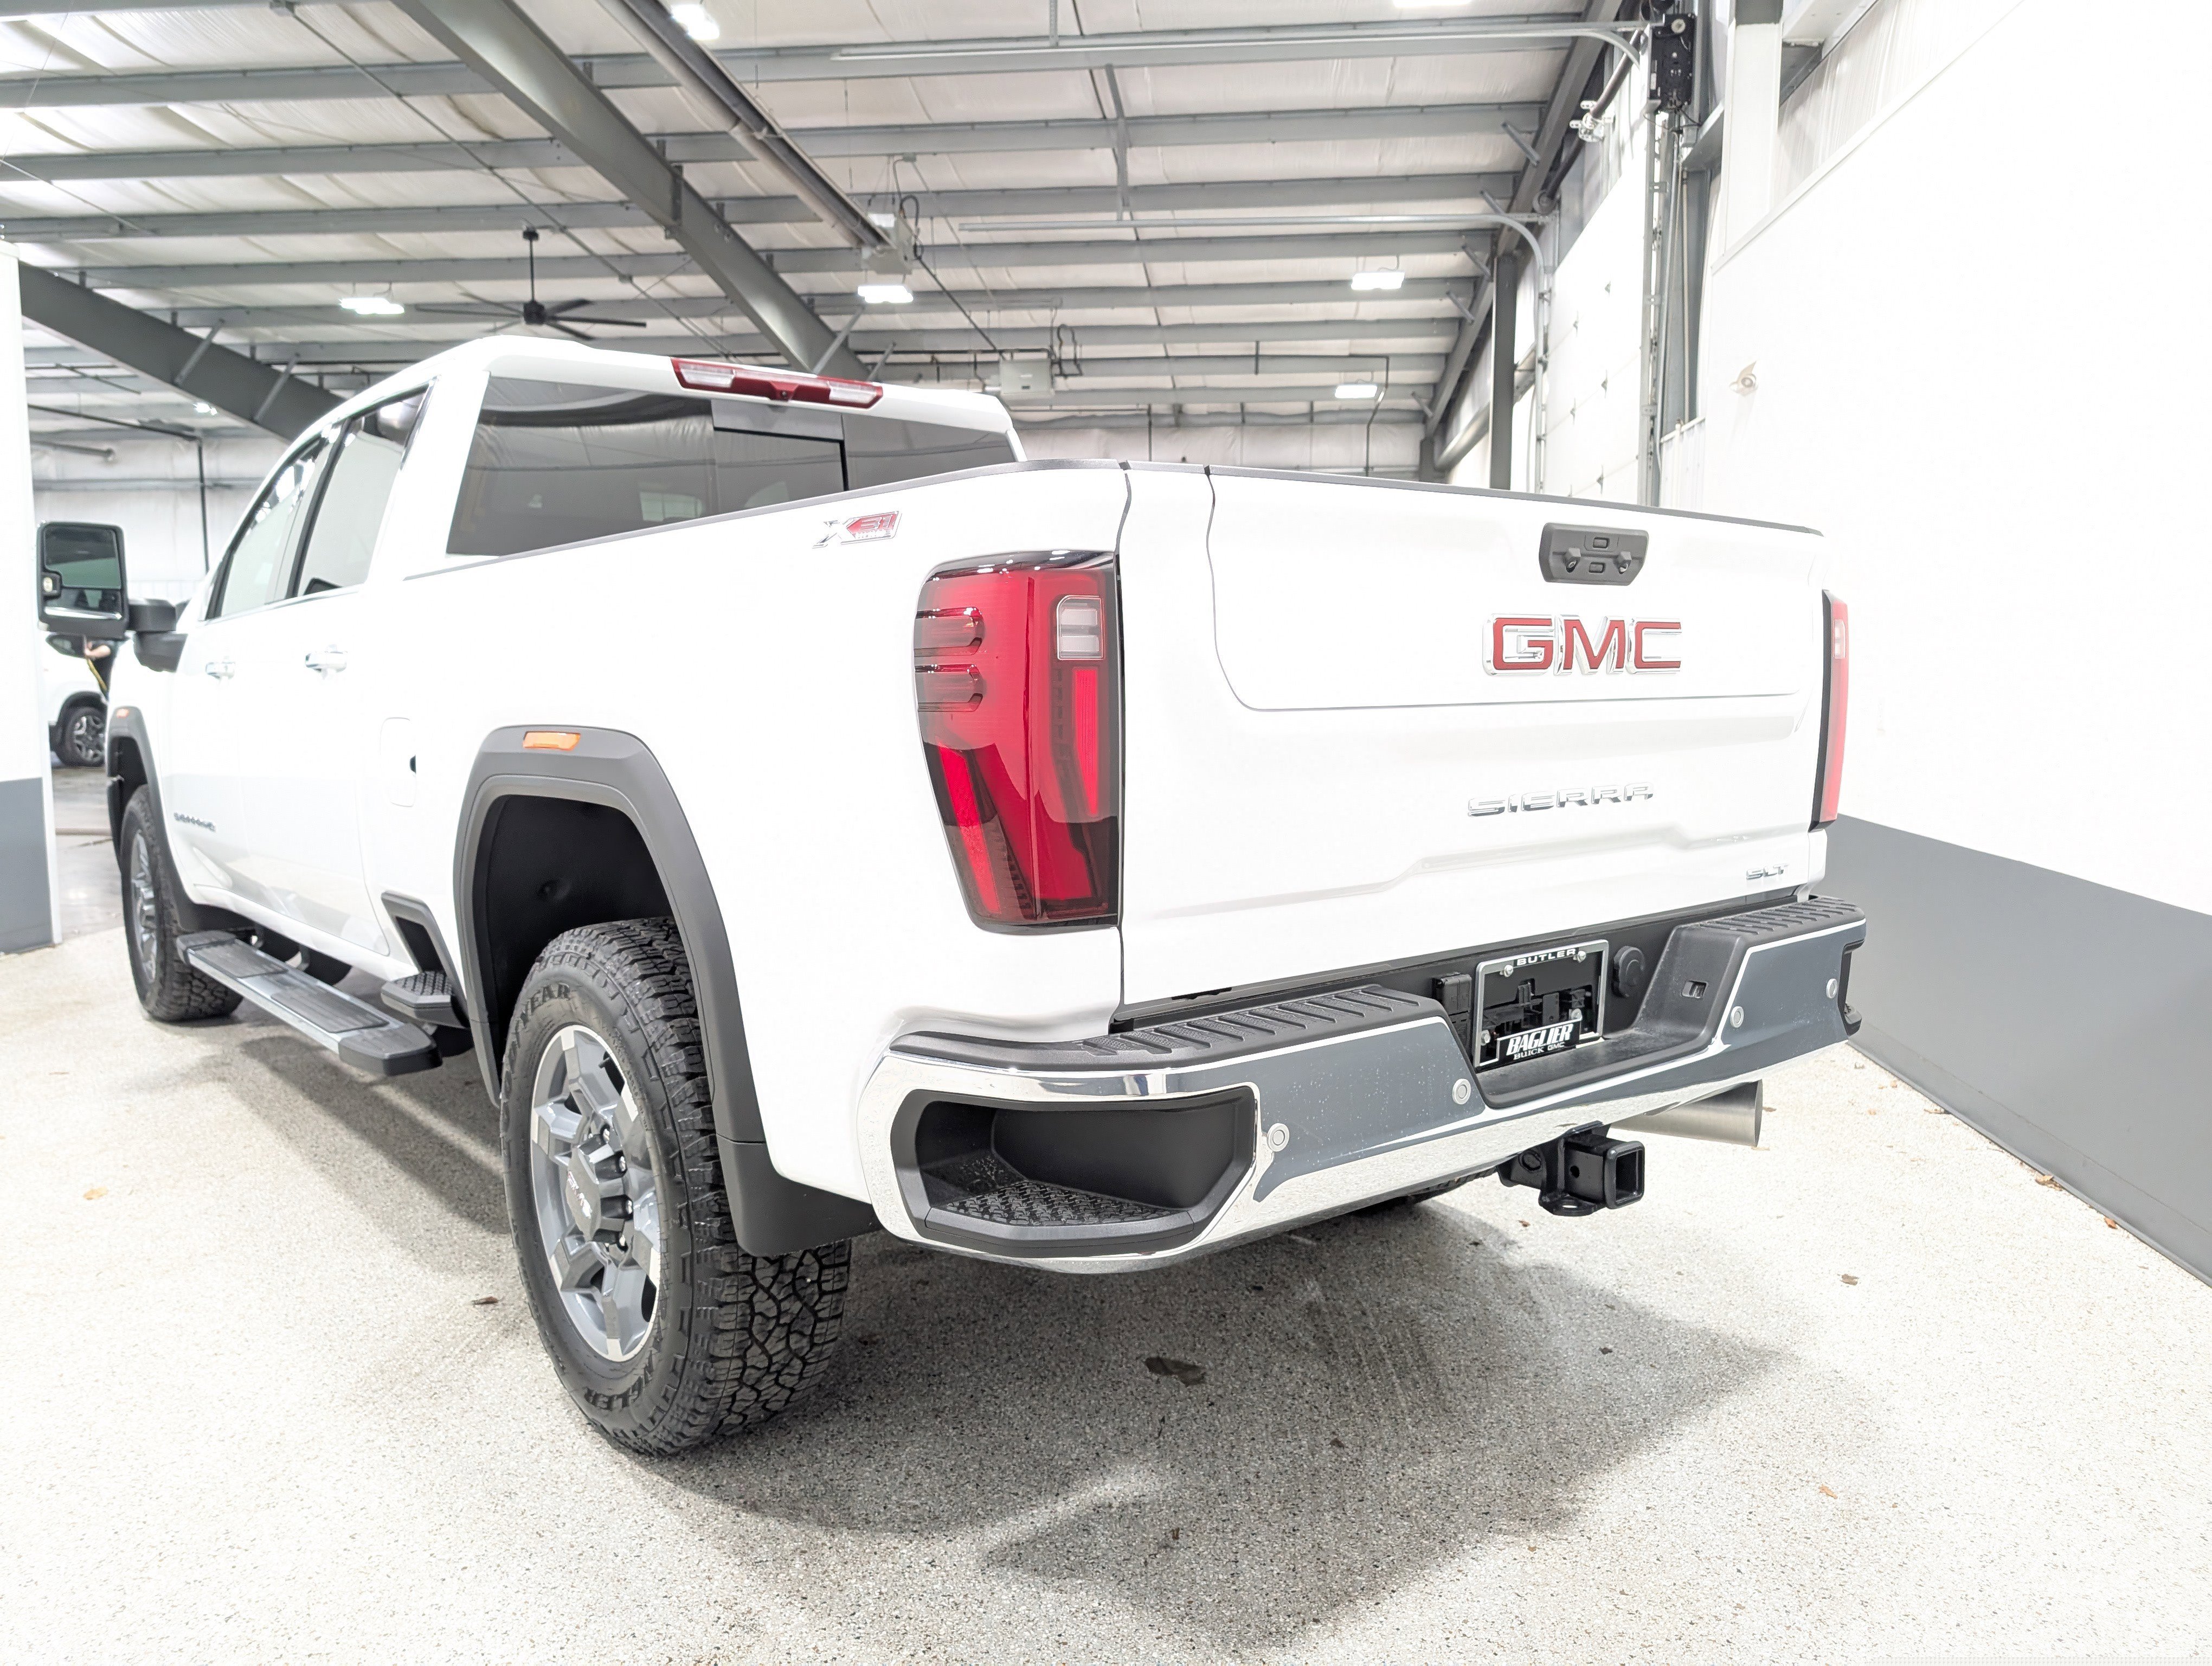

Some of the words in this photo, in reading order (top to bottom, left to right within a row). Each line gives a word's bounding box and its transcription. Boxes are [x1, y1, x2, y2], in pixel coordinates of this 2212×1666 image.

[1482, 613, 1682, 676] GMC
[1467, 781, 1654, 817] SIERRA
[1746, 863, 1790, 880] SLT
[1516, 948, 1577, 966] BUTLER
[1506, 1023, 1574, 1056] BAGLIER
[1513, 1047, 1545, 1061] BUICK
[1547, 1041, 1566, 1052] GMC
